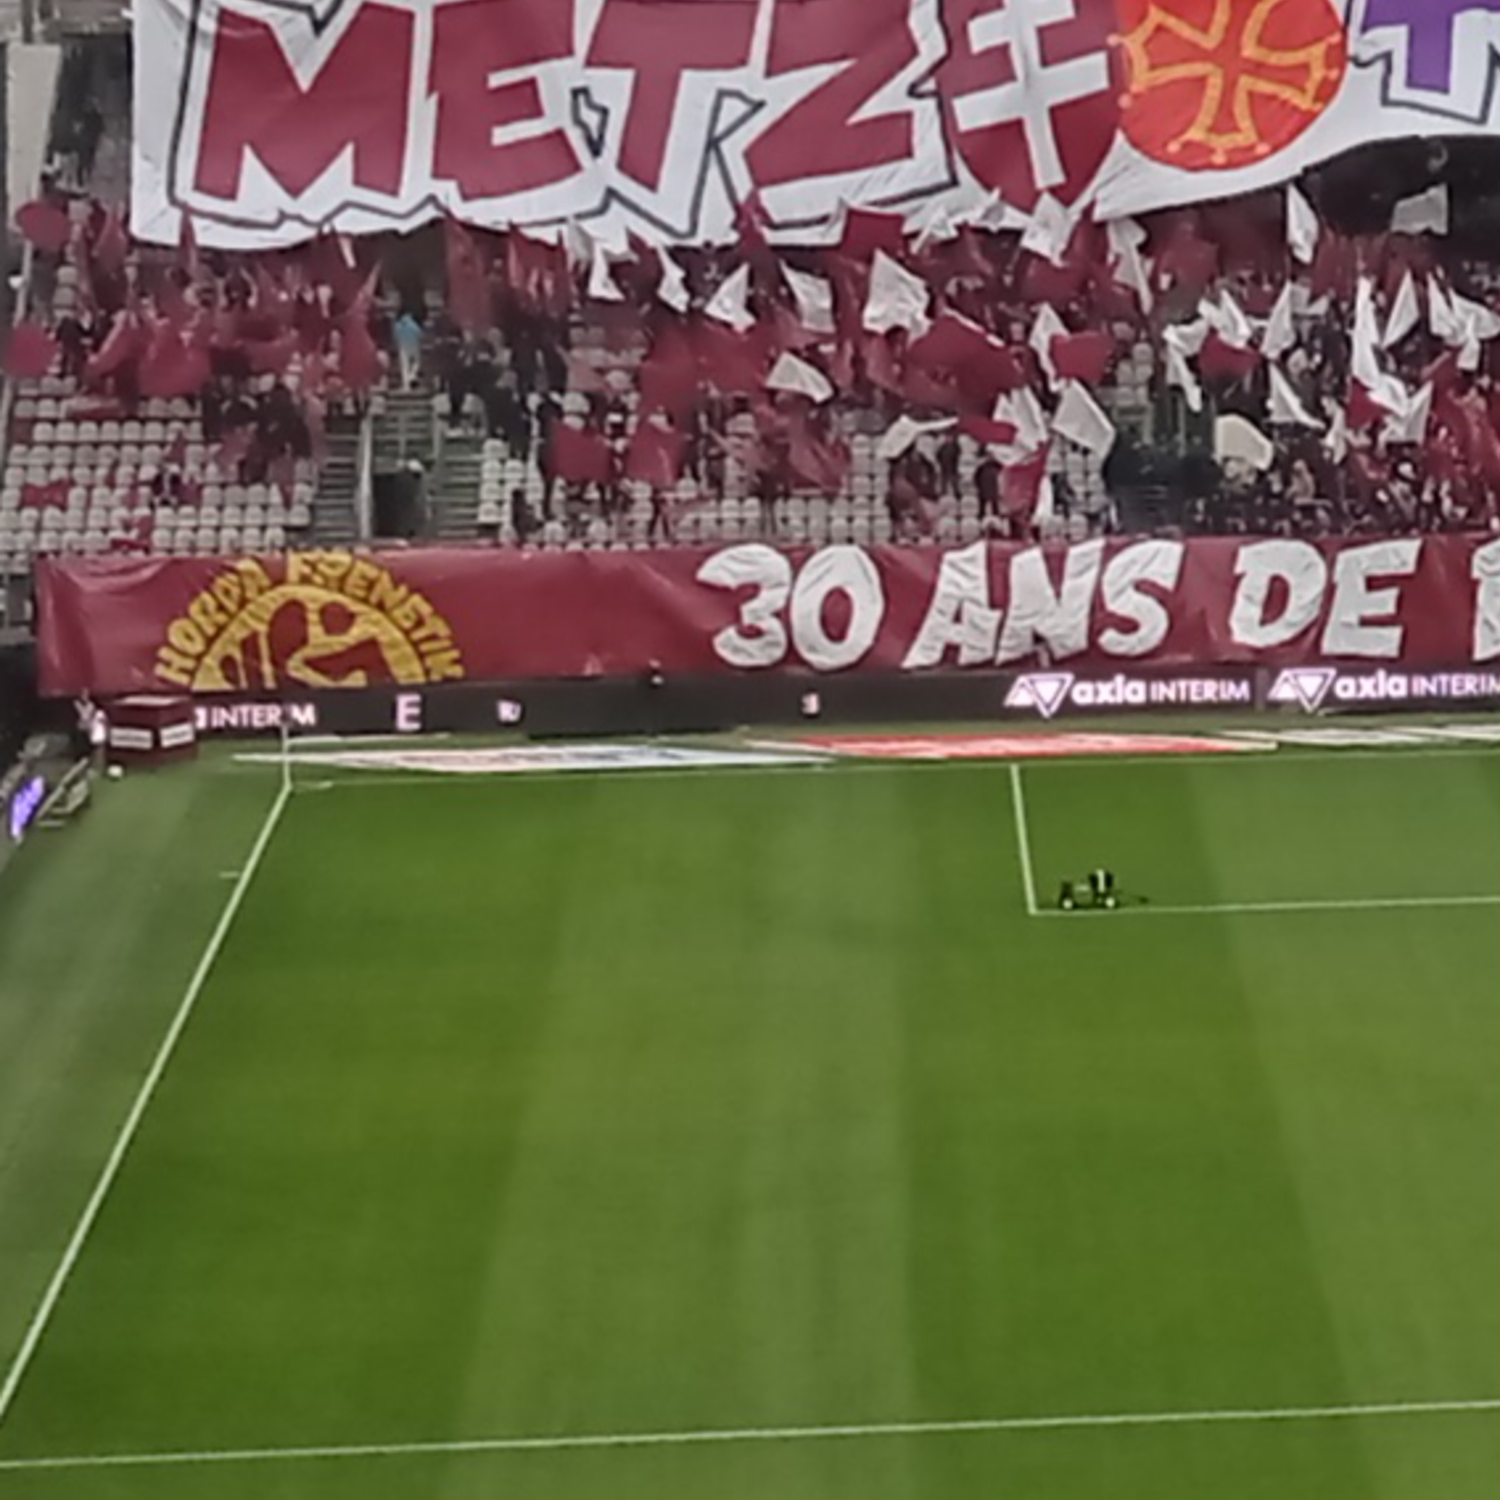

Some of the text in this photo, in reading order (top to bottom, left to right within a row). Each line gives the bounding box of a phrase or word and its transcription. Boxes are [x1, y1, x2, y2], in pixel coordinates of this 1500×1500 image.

[696, 542, 885, 669] 30
[901, 538, 1185, 668] ANS
[1229, 538, 1420, 657] DE
[1151, 678, 1250, 703] INTERIM
[211, 703, 317, 729] INTERM
